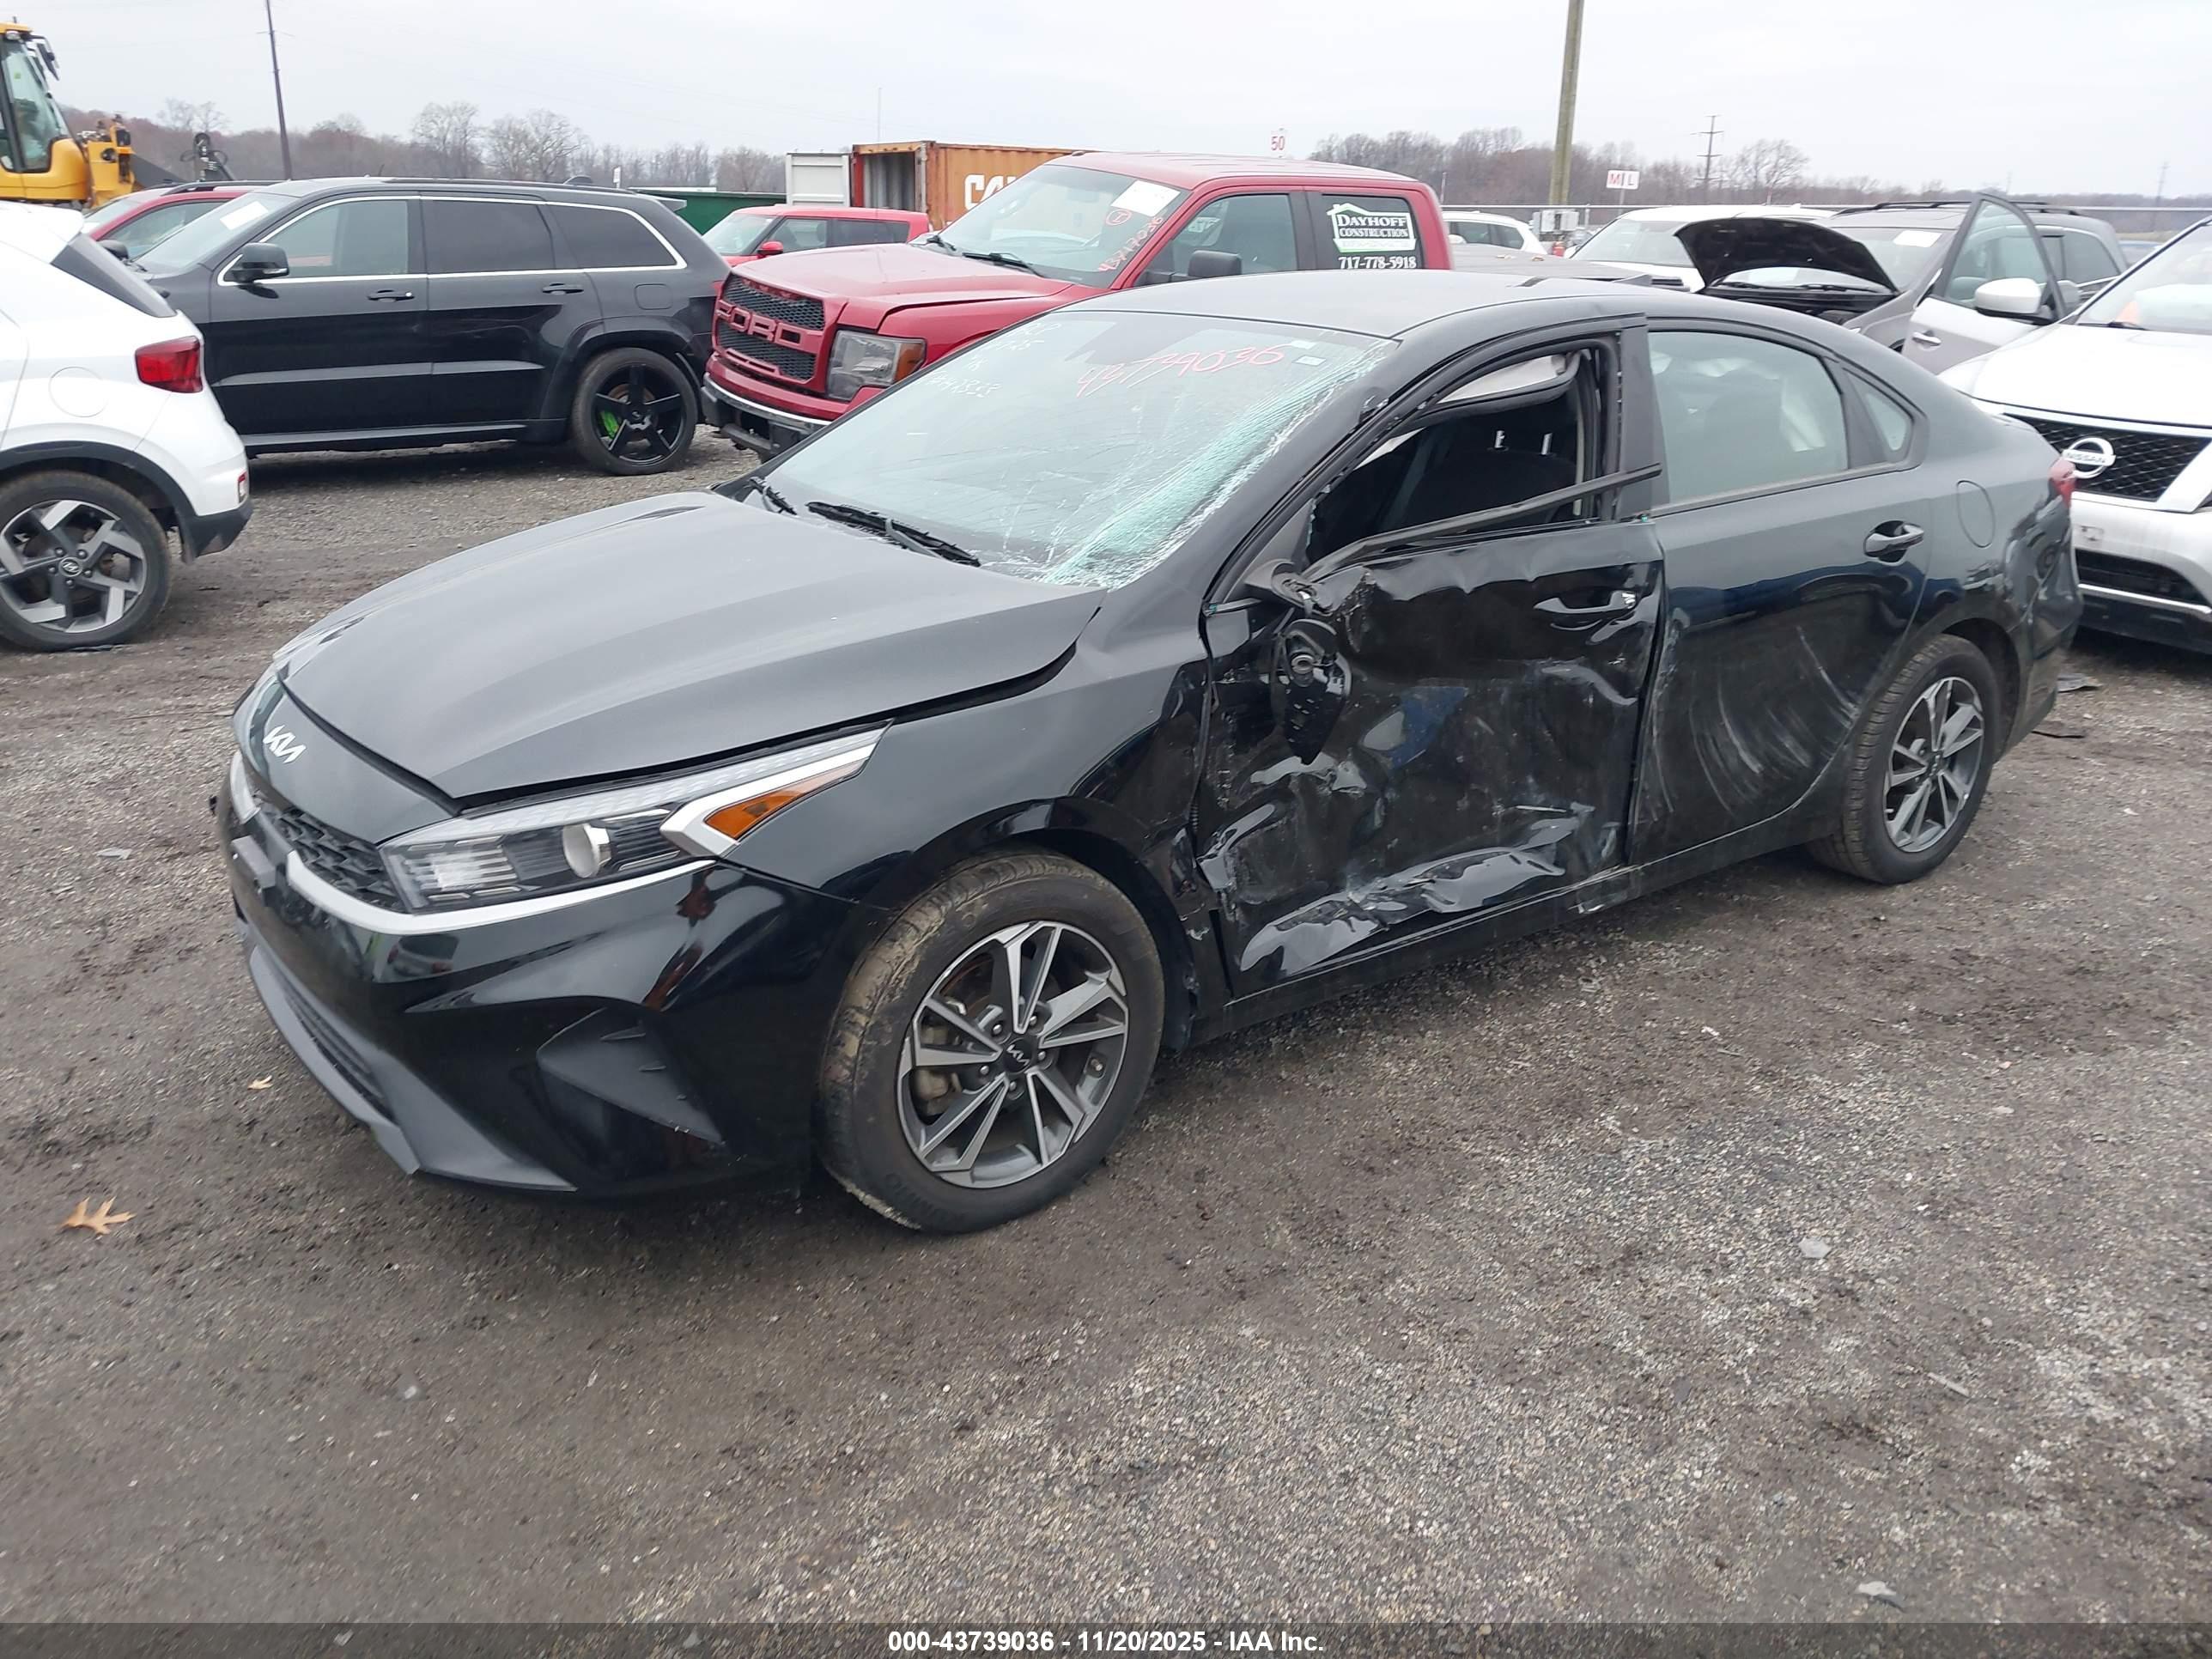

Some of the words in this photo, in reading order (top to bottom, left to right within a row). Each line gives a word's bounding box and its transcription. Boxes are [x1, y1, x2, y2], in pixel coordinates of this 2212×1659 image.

[1271, 136, 1285, 151] 50
[964, 174, 1017, 210] CA
[1337, 214, 1407, 227] DAYHOFF
[1340, 228, 1409, 237] CONSTRUCTION
[1338, 256, 1417, 270] 717-778-5918
[715, 299, 803, 347] FORD
[263, 724, 307, 764] KIA
